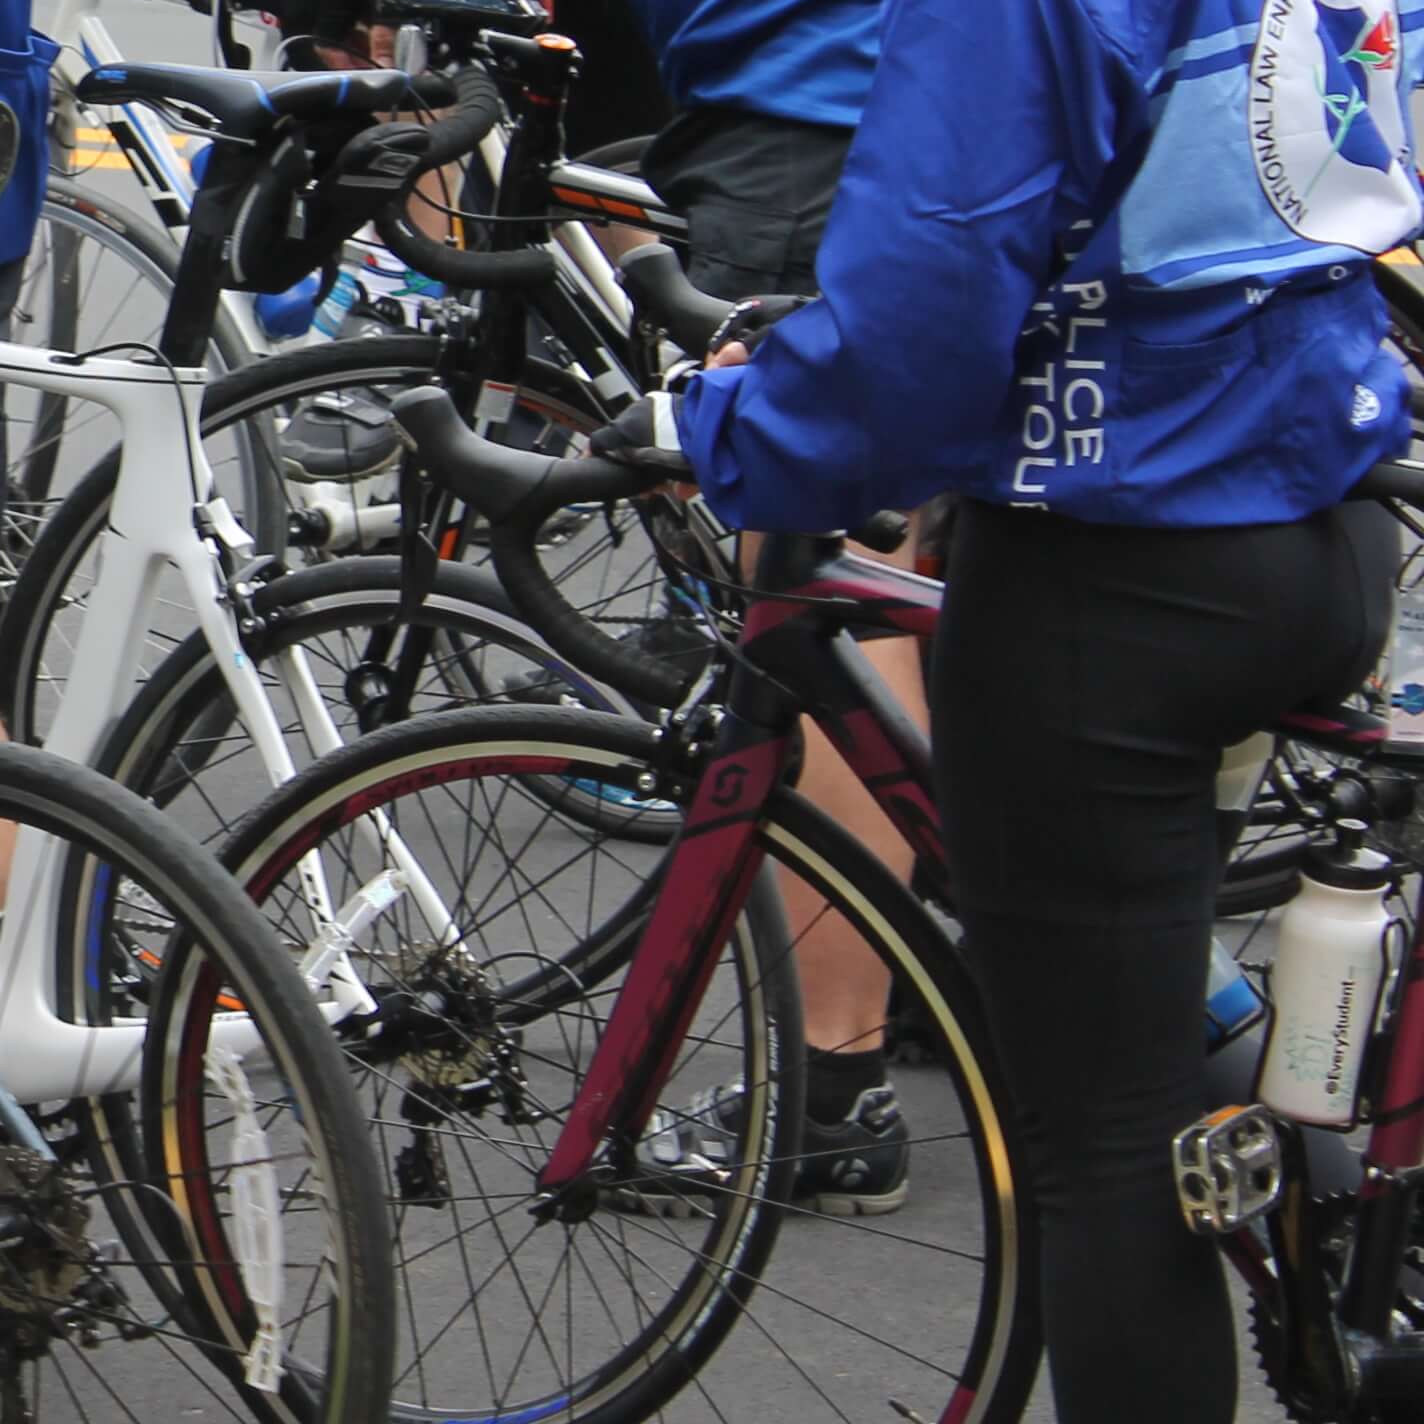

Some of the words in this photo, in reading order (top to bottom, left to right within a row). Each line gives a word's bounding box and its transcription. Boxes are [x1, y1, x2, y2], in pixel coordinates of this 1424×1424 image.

[1253, 46, 1280, 104] LAW
[1251, 114, 1309, 227] NATIONAL
[1060, 280, 1108, 467] PLICE
[1324, 979, 1356, 1096] @EveryStudent
